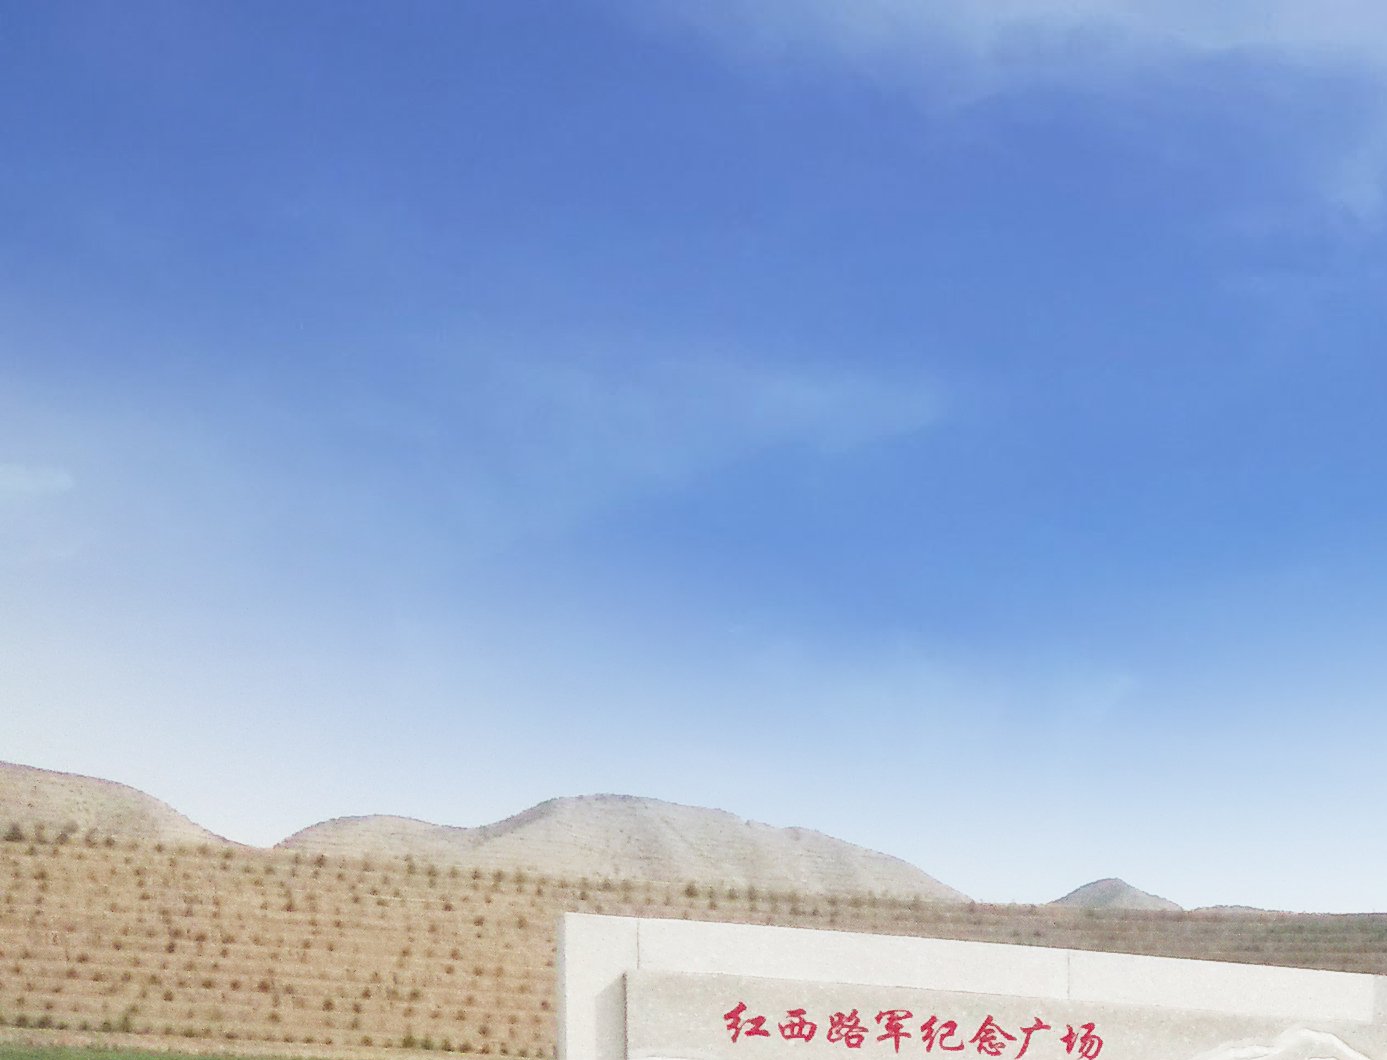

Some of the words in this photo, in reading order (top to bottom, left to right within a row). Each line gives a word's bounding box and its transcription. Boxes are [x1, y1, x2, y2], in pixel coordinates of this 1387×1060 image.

[722, 1001, 1104, 1060] 红西路军纪念广场
